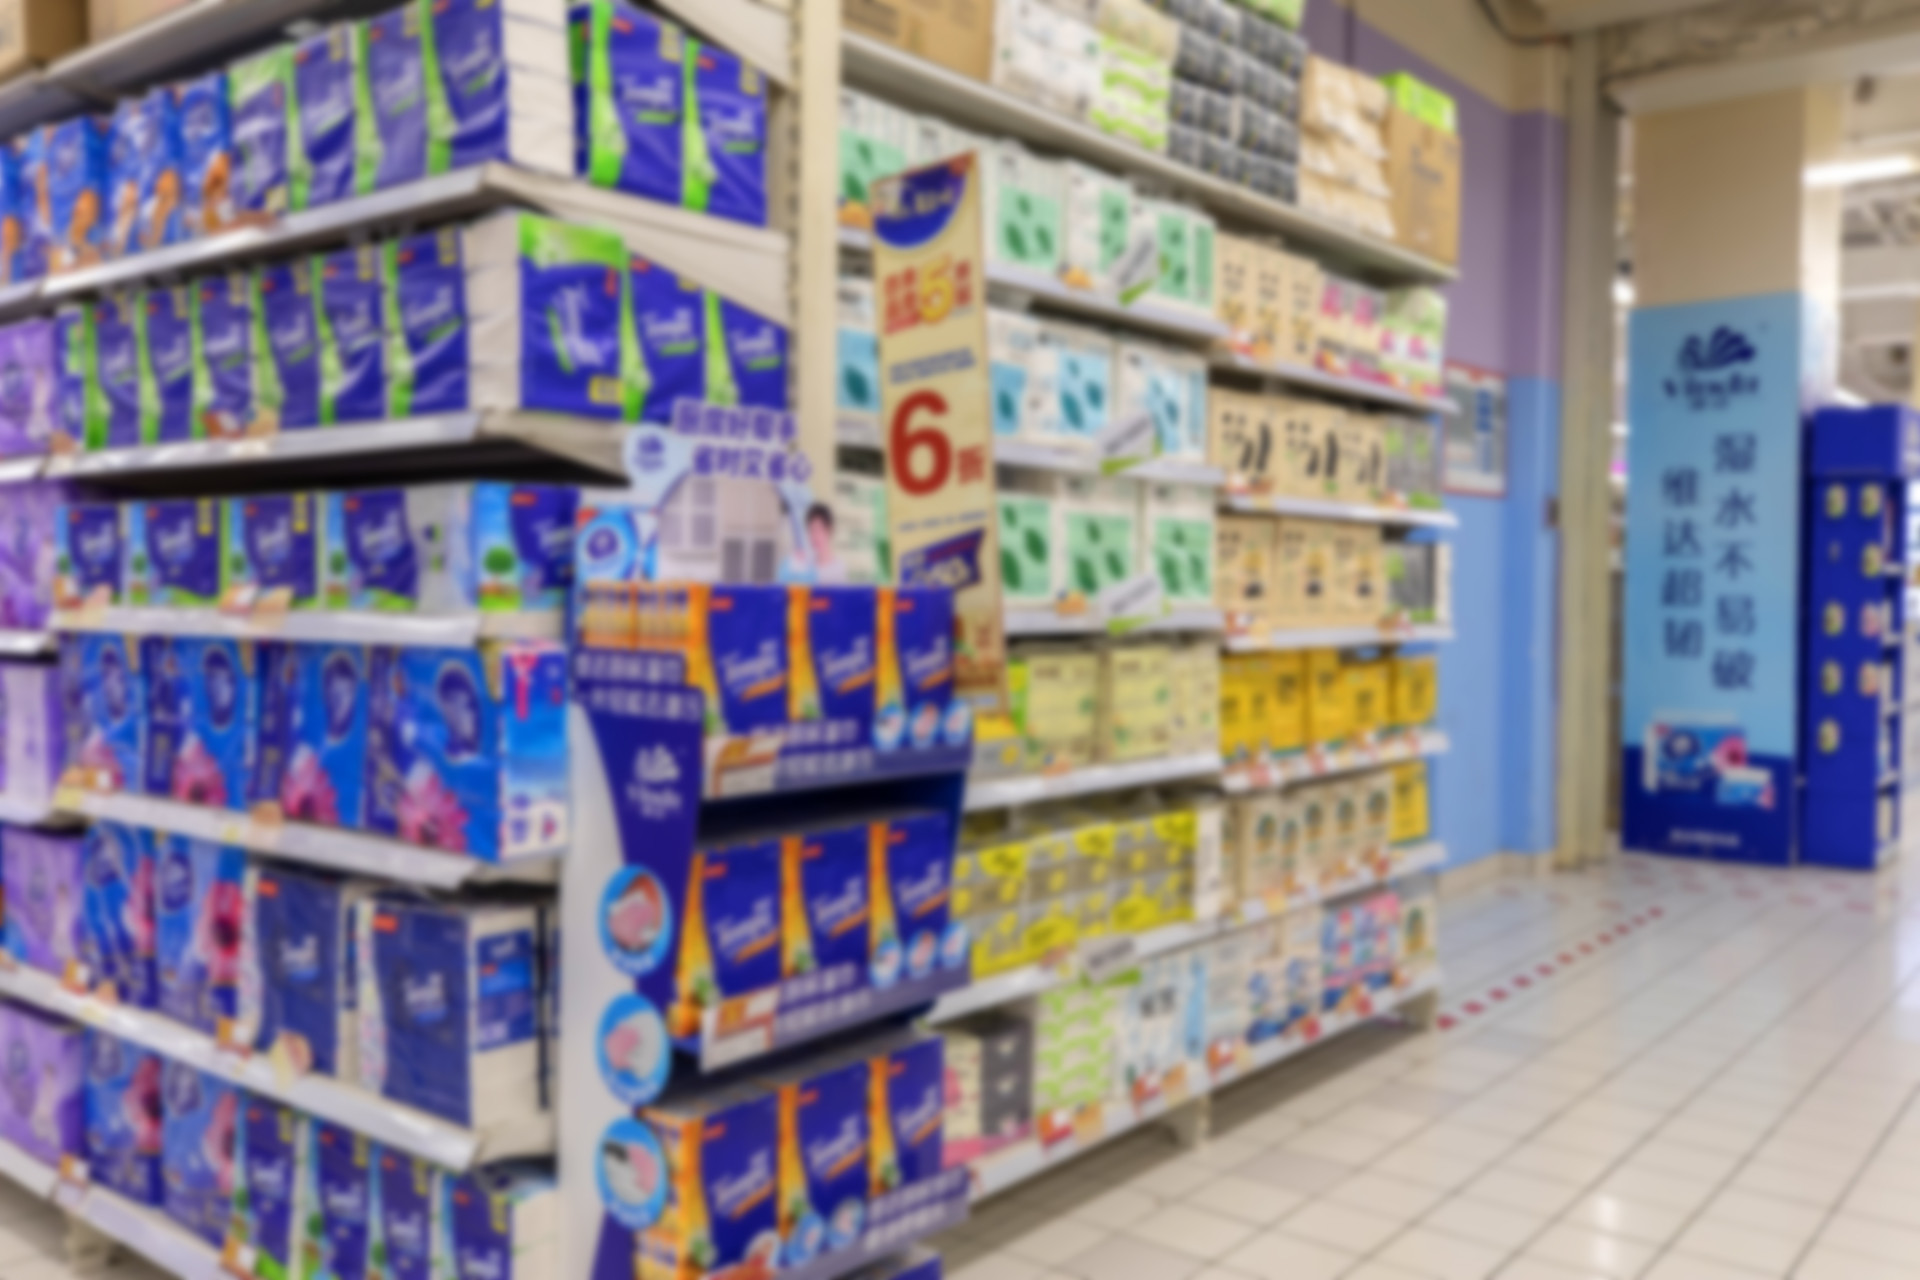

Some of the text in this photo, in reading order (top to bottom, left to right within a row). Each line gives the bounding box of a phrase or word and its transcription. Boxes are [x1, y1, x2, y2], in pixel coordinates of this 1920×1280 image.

[692, 443, 813, 483] 省时又省心
[1661, 467, 1702, 660] 维达超韧
[1711, 433, 1756, 691] 湿水不易破
